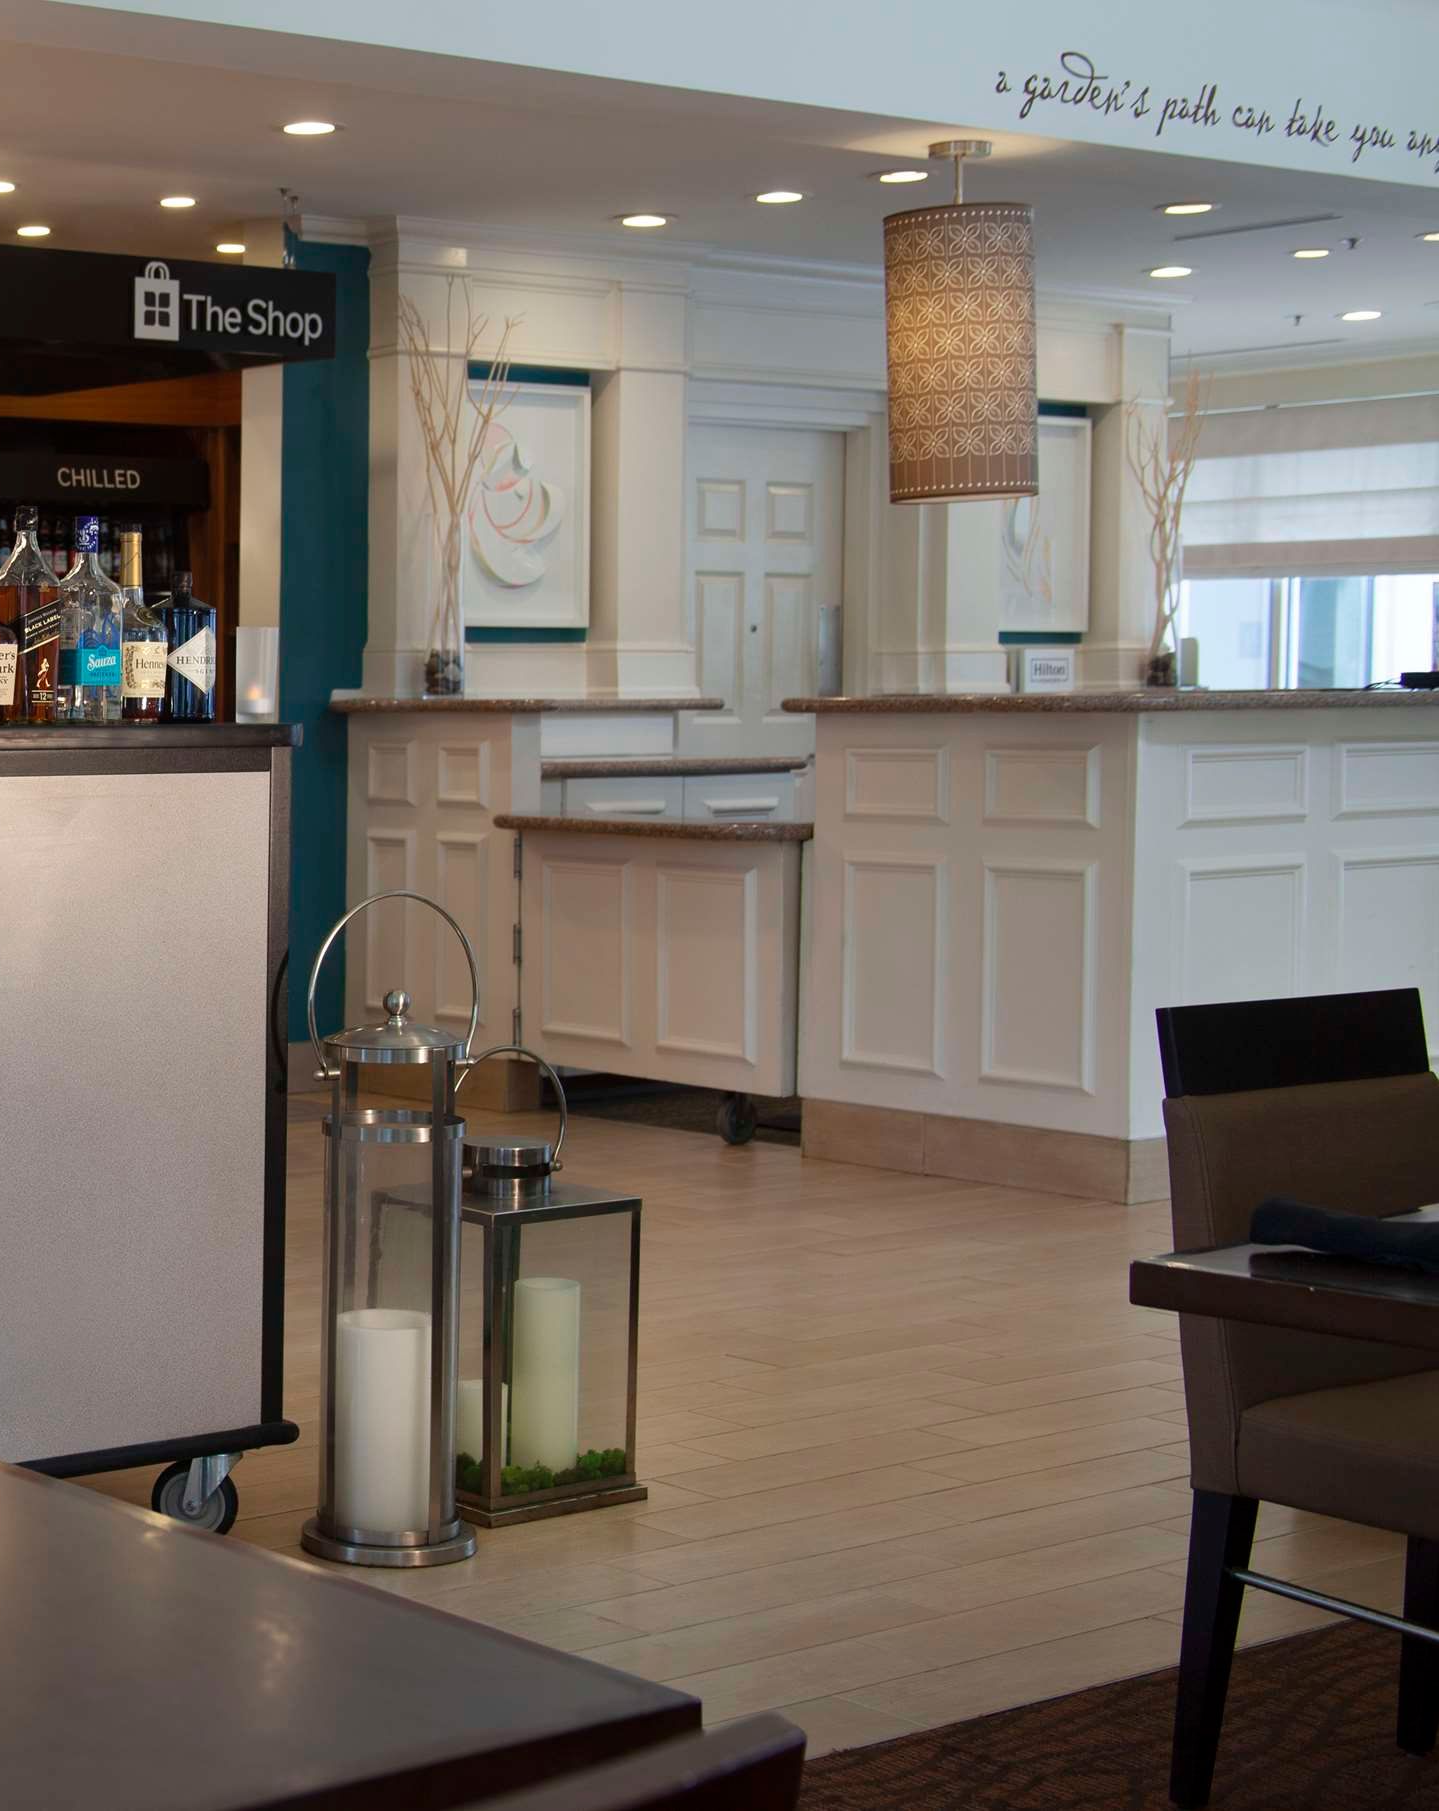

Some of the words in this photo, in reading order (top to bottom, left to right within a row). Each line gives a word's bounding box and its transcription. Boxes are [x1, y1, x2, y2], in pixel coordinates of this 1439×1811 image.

[995, 70, 1011, 94] a
[1018, 51, 1151, 119] garden's
[1156, 83, 1222, 136] path
[1232, 104, 1275, 137] can
[1285, 97, 1340, 147] take
[1350, 124, 1396, 163] you
[183, 293, 242, 334] The
[247, 298, 323, 346] Shop
[57, 467, 141, 489] CHILLED
[87, 654, 117, 671] Sauza
[1033, 663, 1065, 676] Hilton
